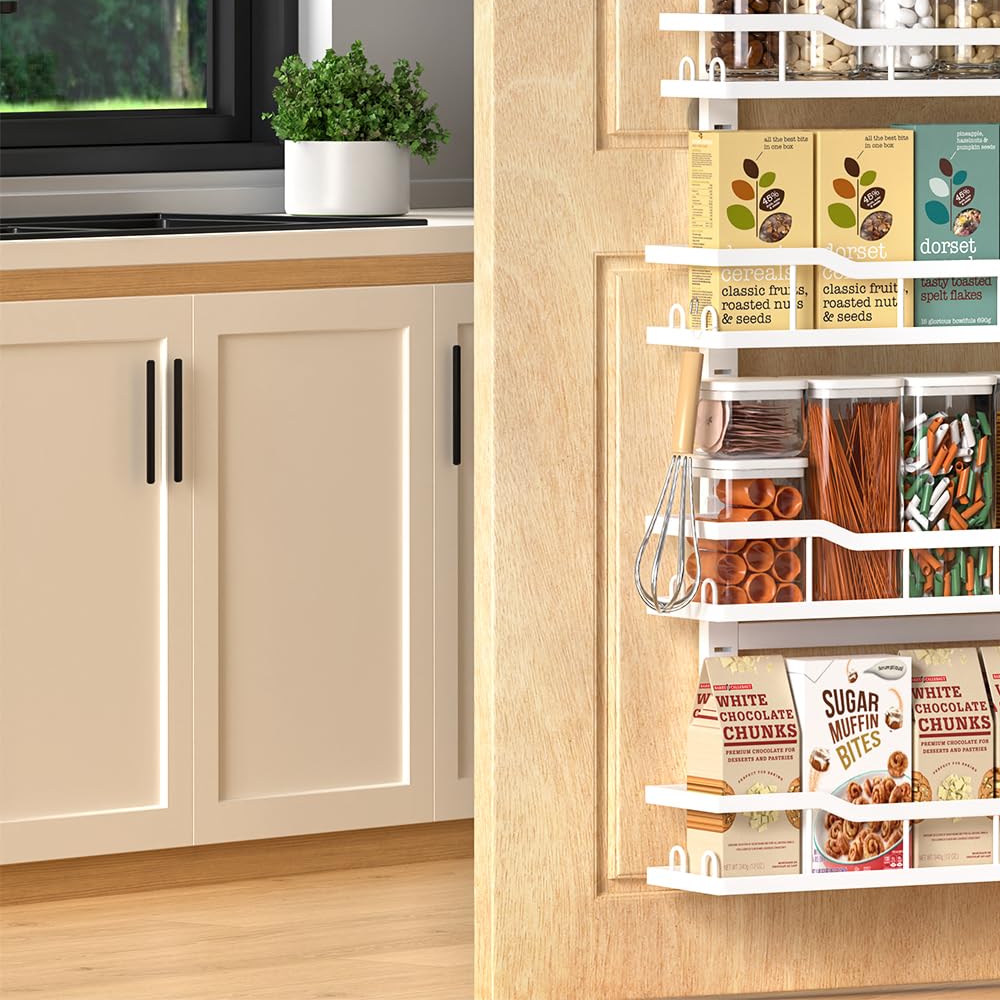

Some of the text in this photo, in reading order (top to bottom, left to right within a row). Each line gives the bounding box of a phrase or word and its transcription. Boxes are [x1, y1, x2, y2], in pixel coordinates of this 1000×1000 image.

[920, 238, 976, 254] dorset
[721, 265, 791, 282] cereals
[823, 284, 866, 295] classic
[921, 277, 992, 290] tasty toasted
[722, 285, 766, 296] classic
[921, 290, 982, 303] spelt flakes
[722, 298, 770, 310] roasted
[823, 296, 870, 308] roasted
[722, 312, 772, 324] & seeds
[823, 311, 872, 322] & seeds
[912, 686, 962, 699] WHITE
[716, 694, 768, 707] WHITE
[823, 689, 879, 718] SUGAR
[915, 701, 988, 714] CHOCOLATE
[720, 710, 794, 722] CHOCOLATE
[828, 715, 879, 744] MUFFIN
[918, 715, 991, 732] CHUNKS
[723, 724, 798, 740] CHUNKS
[836, 730, 882, 770] BITES
